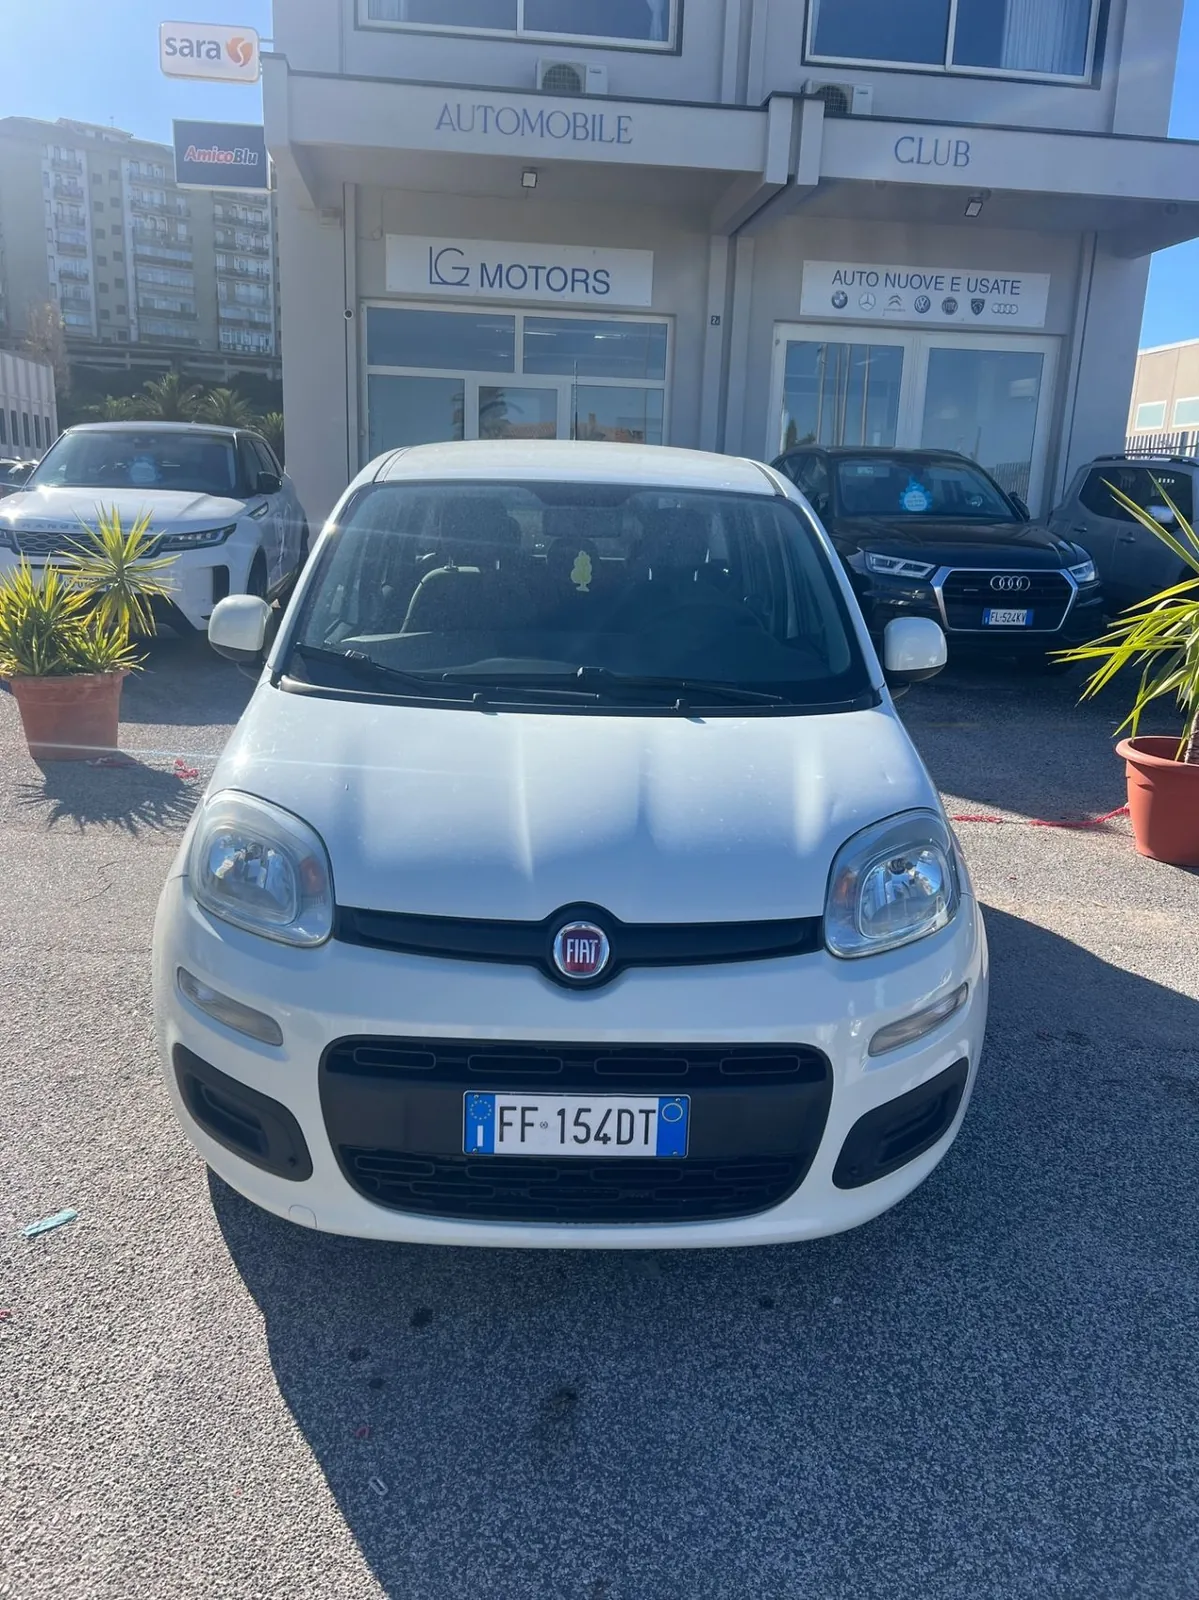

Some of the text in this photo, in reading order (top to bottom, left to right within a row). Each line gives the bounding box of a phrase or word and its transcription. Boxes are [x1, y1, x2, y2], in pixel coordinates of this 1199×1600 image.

[164, 36, 222, 61] sara
[434, 102, 634, 145] AUTOMOBILE
[184, 144, 259, 166] AmicoBlu
[893, 135, 971, 167] CLUB
[428, 245, 611, 296] LG MOTORS
[831, 269, 1022, 297] AUTO NUOVE E USATE
[566, 938, 599, 964] FIAT
[498, 1105, 539, 1143] FF
[556, 1107, 657, 1146] 154DT
